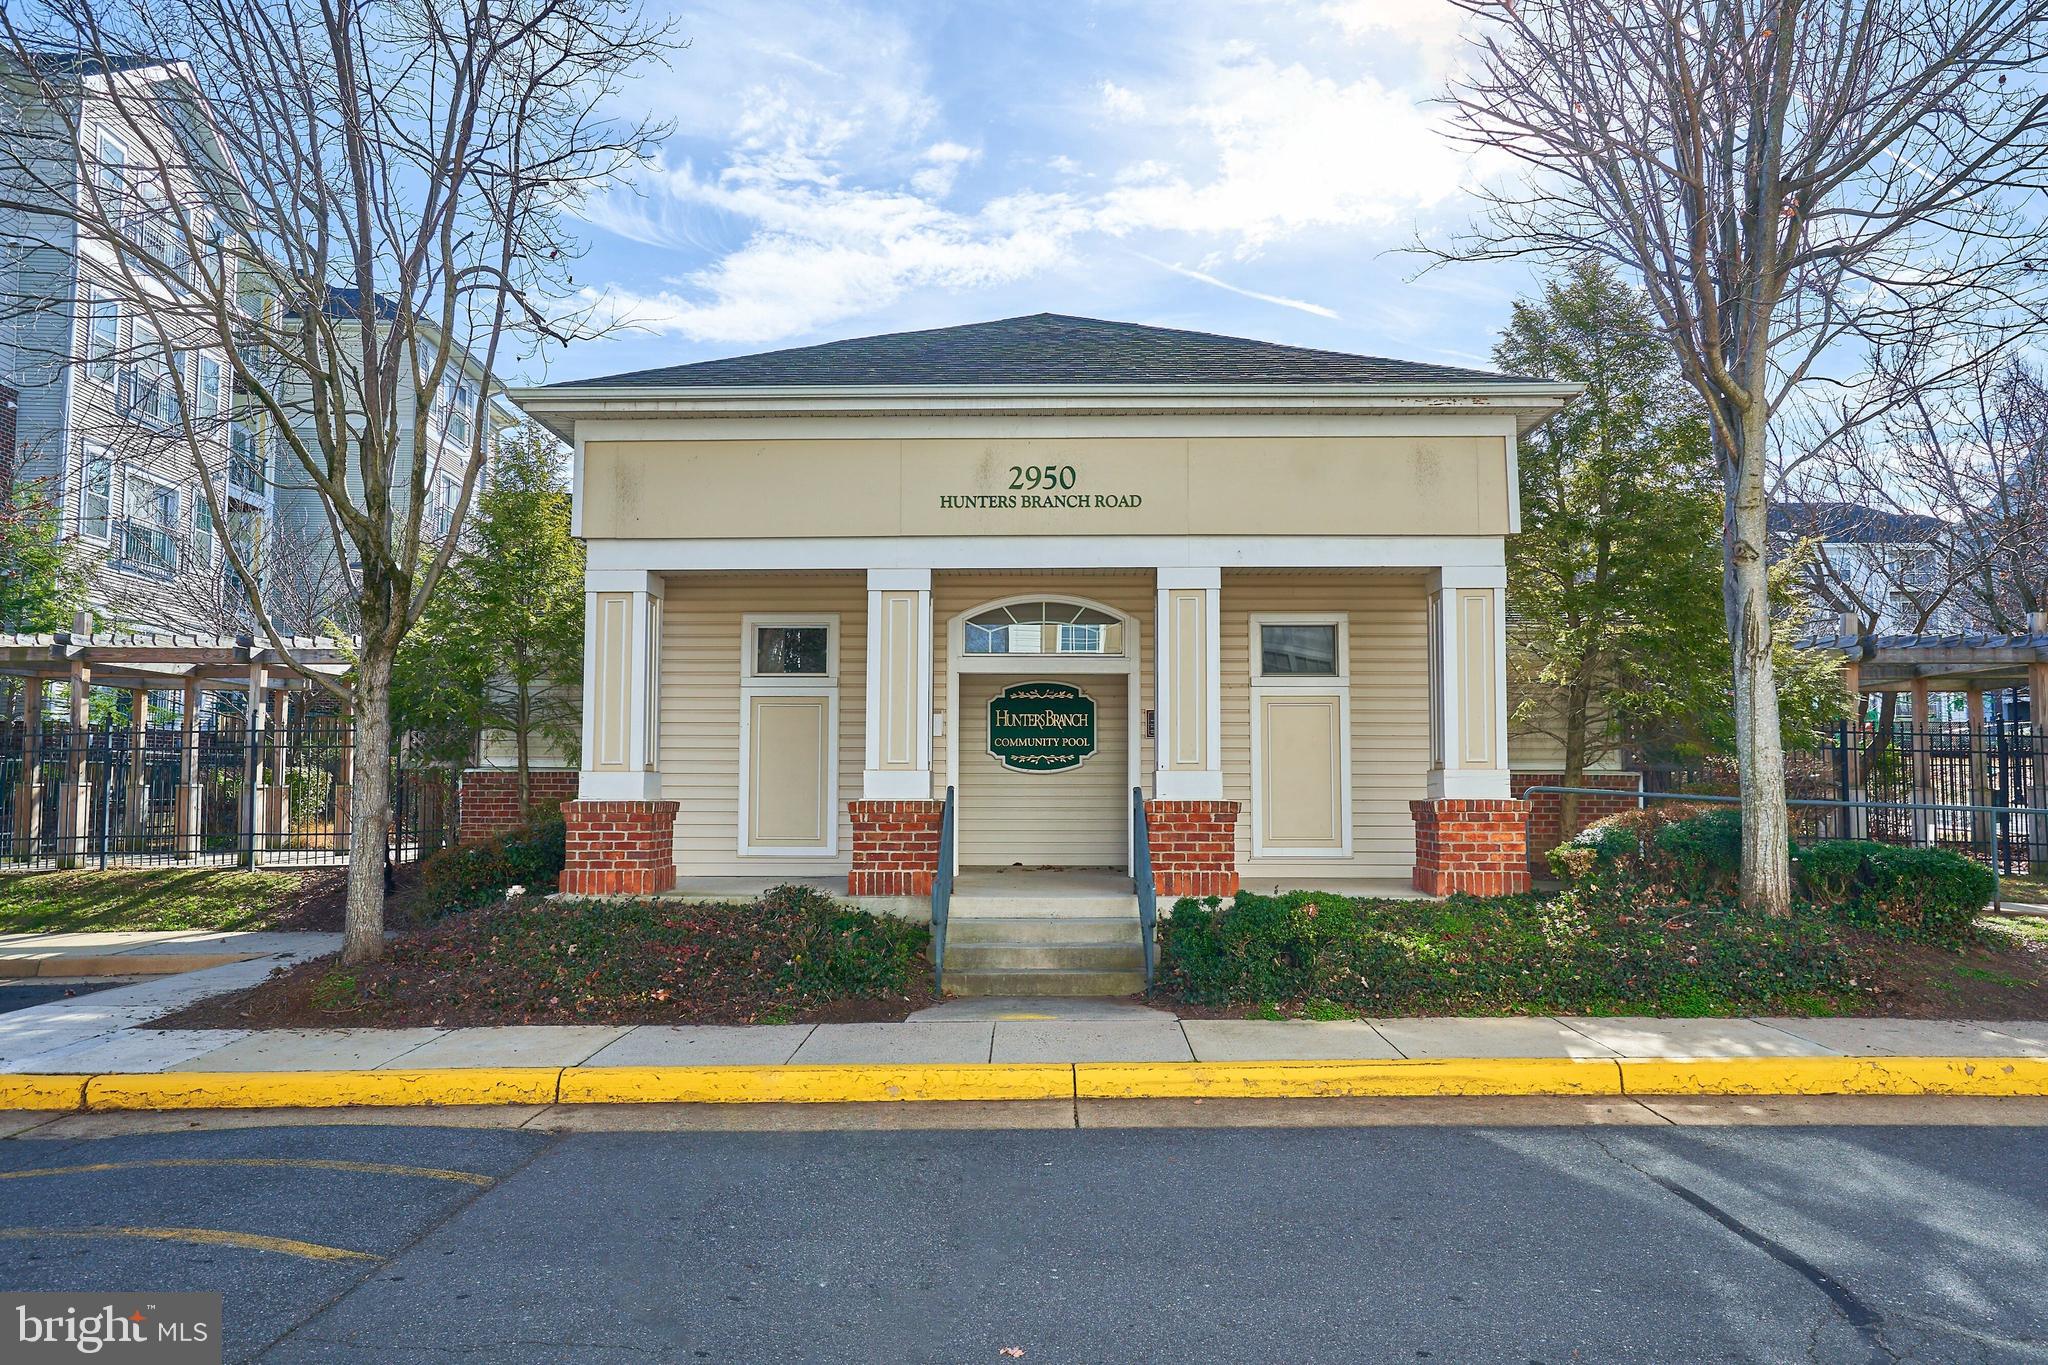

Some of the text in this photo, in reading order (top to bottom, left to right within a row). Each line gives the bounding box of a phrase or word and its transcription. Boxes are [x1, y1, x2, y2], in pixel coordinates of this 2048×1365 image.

[1008, 465, 1077, 491] 2950
[940, 494, 1142, 509] HUNTERS BRANCH ROAD
[994, 737, 1090, 747] COMMUNITY POOL
